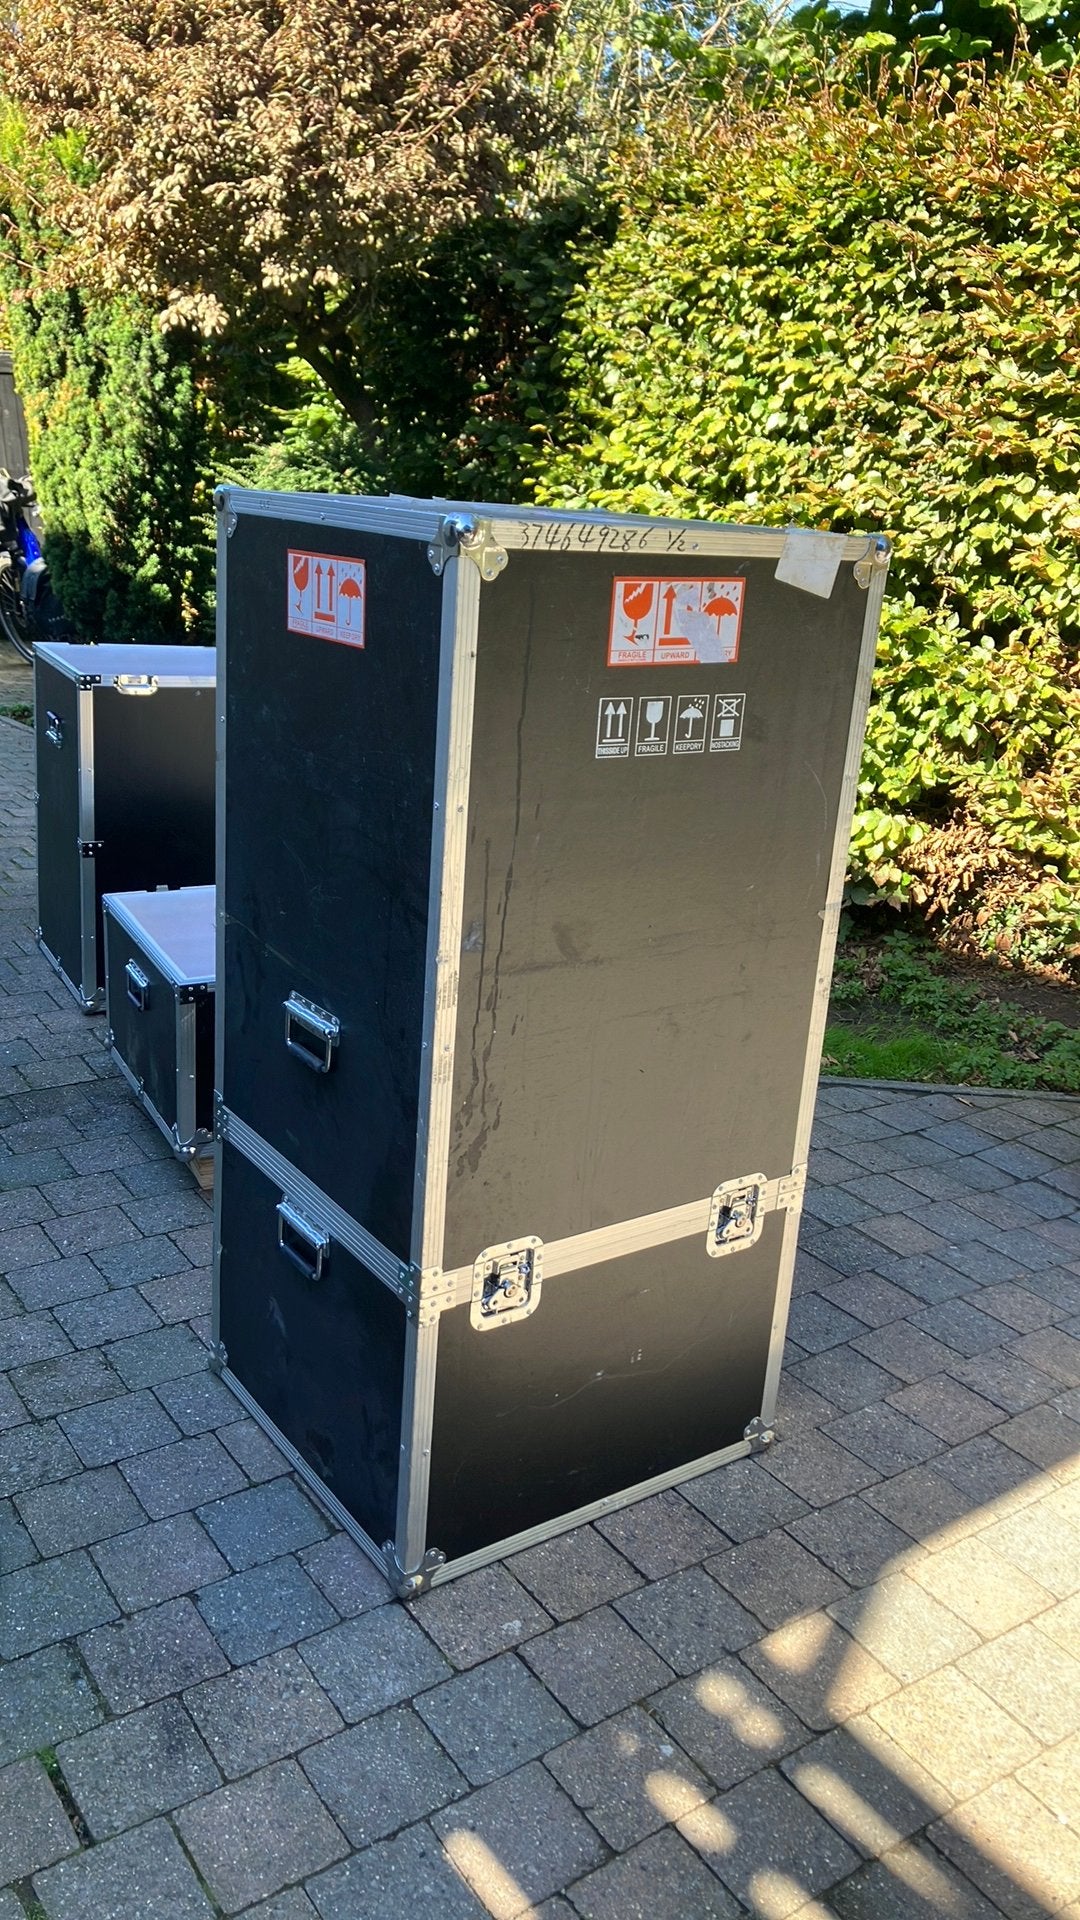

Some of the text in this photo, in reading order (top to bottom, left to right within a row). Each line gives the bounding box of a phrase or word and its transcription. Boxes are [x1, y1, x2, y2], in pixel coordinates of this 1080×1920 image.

[518, 521, 655, 552] 374649286
[617, 650, 647, 659] FRAGILE
[660, 651, 690, 659] UPWARD
[637, 744, 664, 753] FRAGILE
